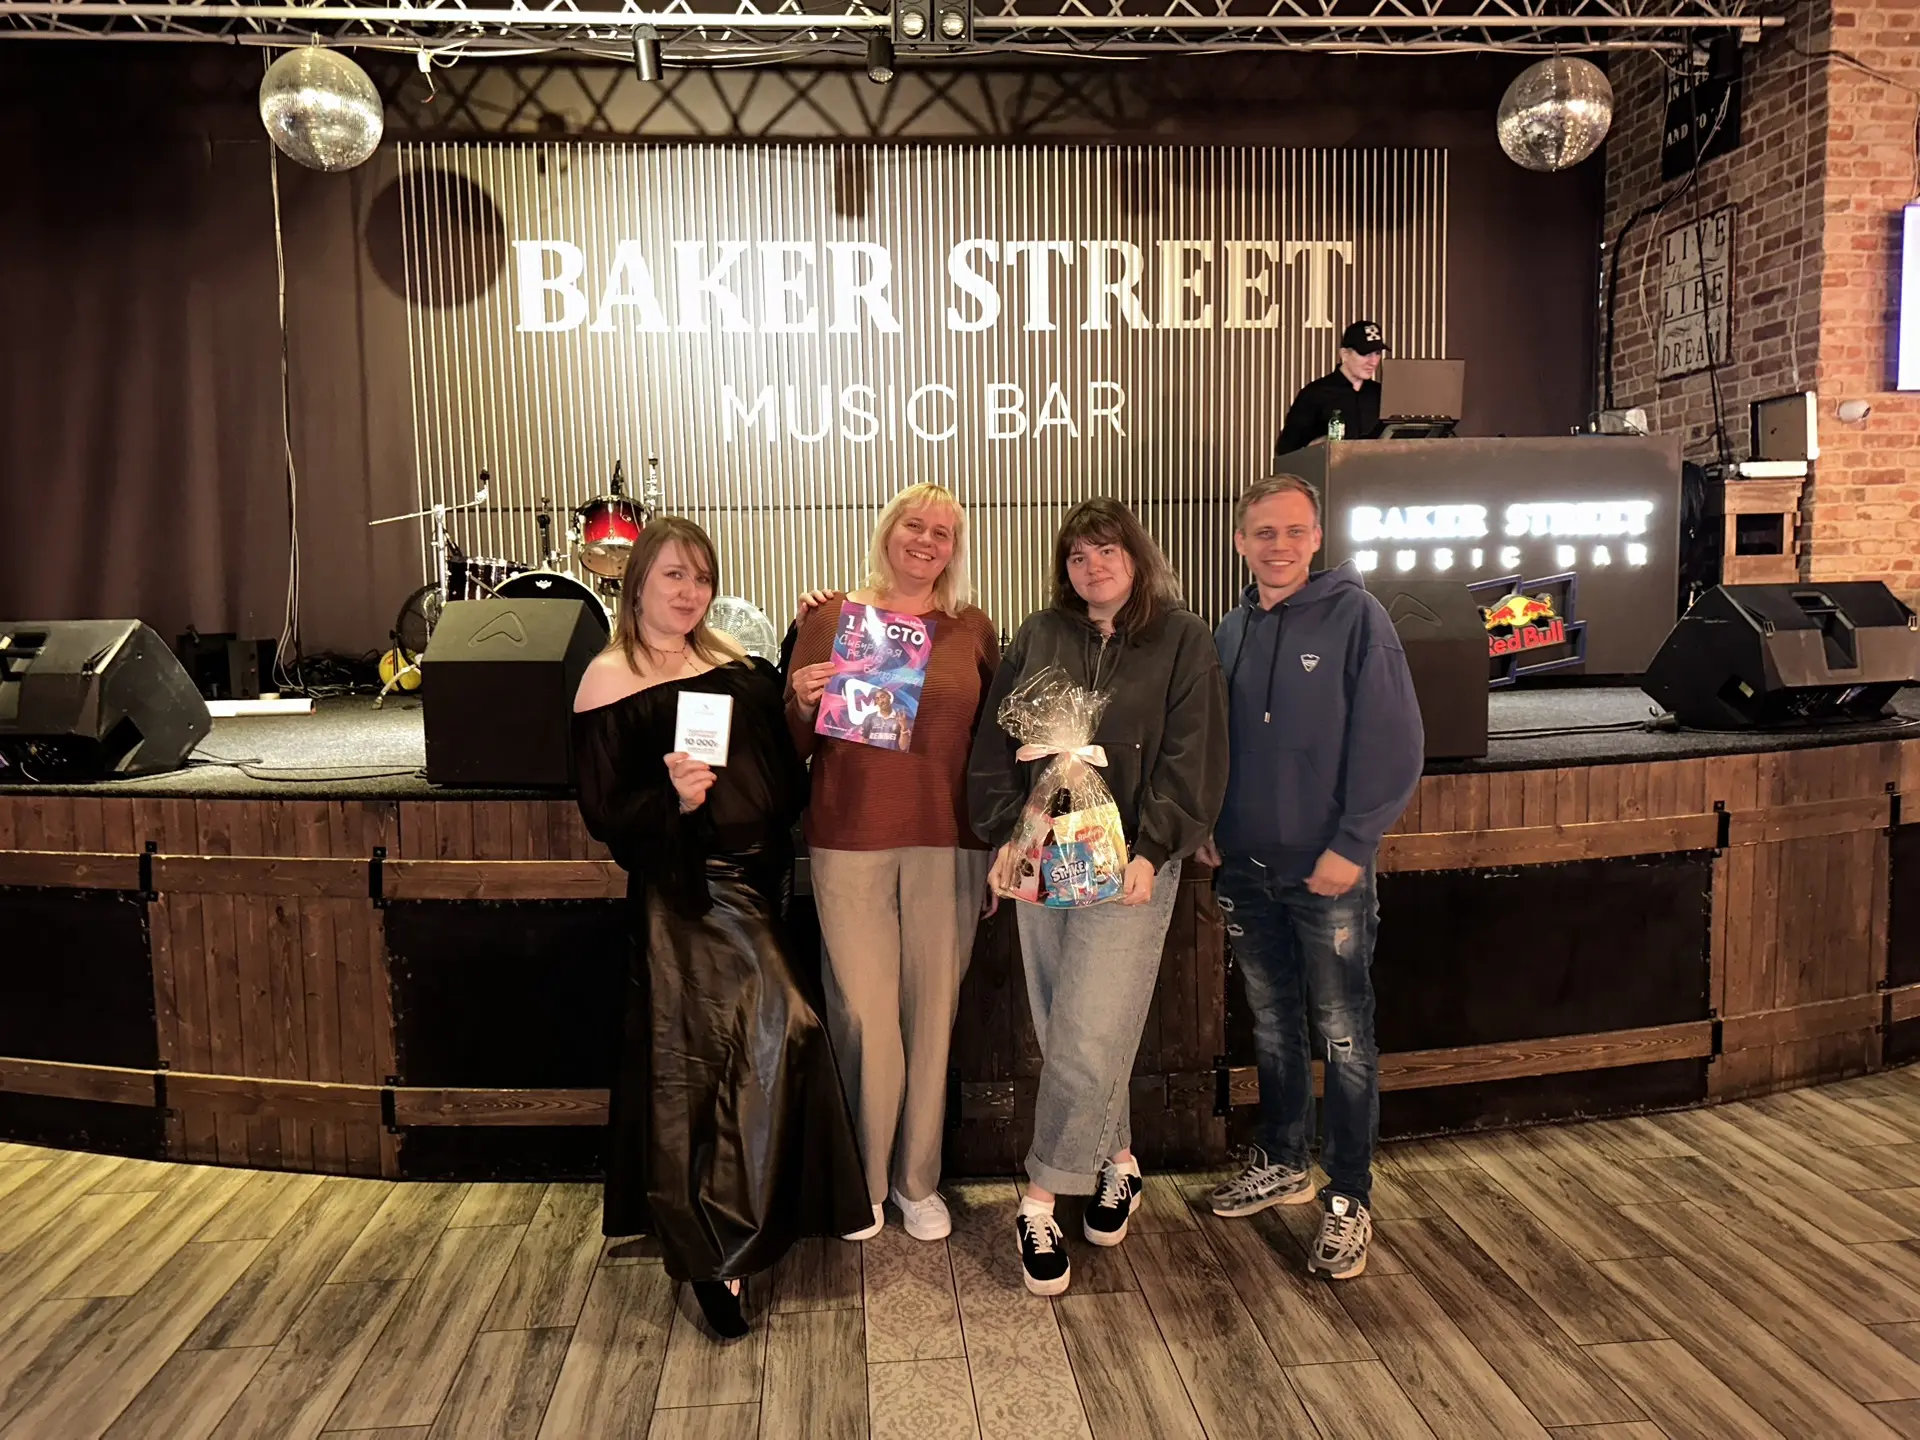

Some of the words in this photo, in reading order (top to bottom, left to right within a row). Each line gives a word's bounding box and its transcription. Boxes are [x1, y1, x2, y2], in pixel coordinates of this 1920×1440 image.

[1666, 123, 1688, 148] AND
[1665, 214, 1726, 267] LIVE
[513, 239, 901, 334] BAKER
[946, 238, 1354, 333] STREET
[1663, 272, 1723, 320] LIFE
[1662, 330, 1720, 371] DREAM
[722, 383, 958, 444] MUSIC
[987, 380, 1127, 440] BAR
[1351, 506, 1488, 541] BAKER
[1505, 500, 1653, 537] STREET
[1355, 546, 1521, 572] MUSIC
[1557, 542, 1647, 569] BAR
[845, 614, 855, 632] 1
[859, 618, 926, 646] МСТО
[1523, 620, 1565, 649] Bull
[684, 738, 695, 747] 10
